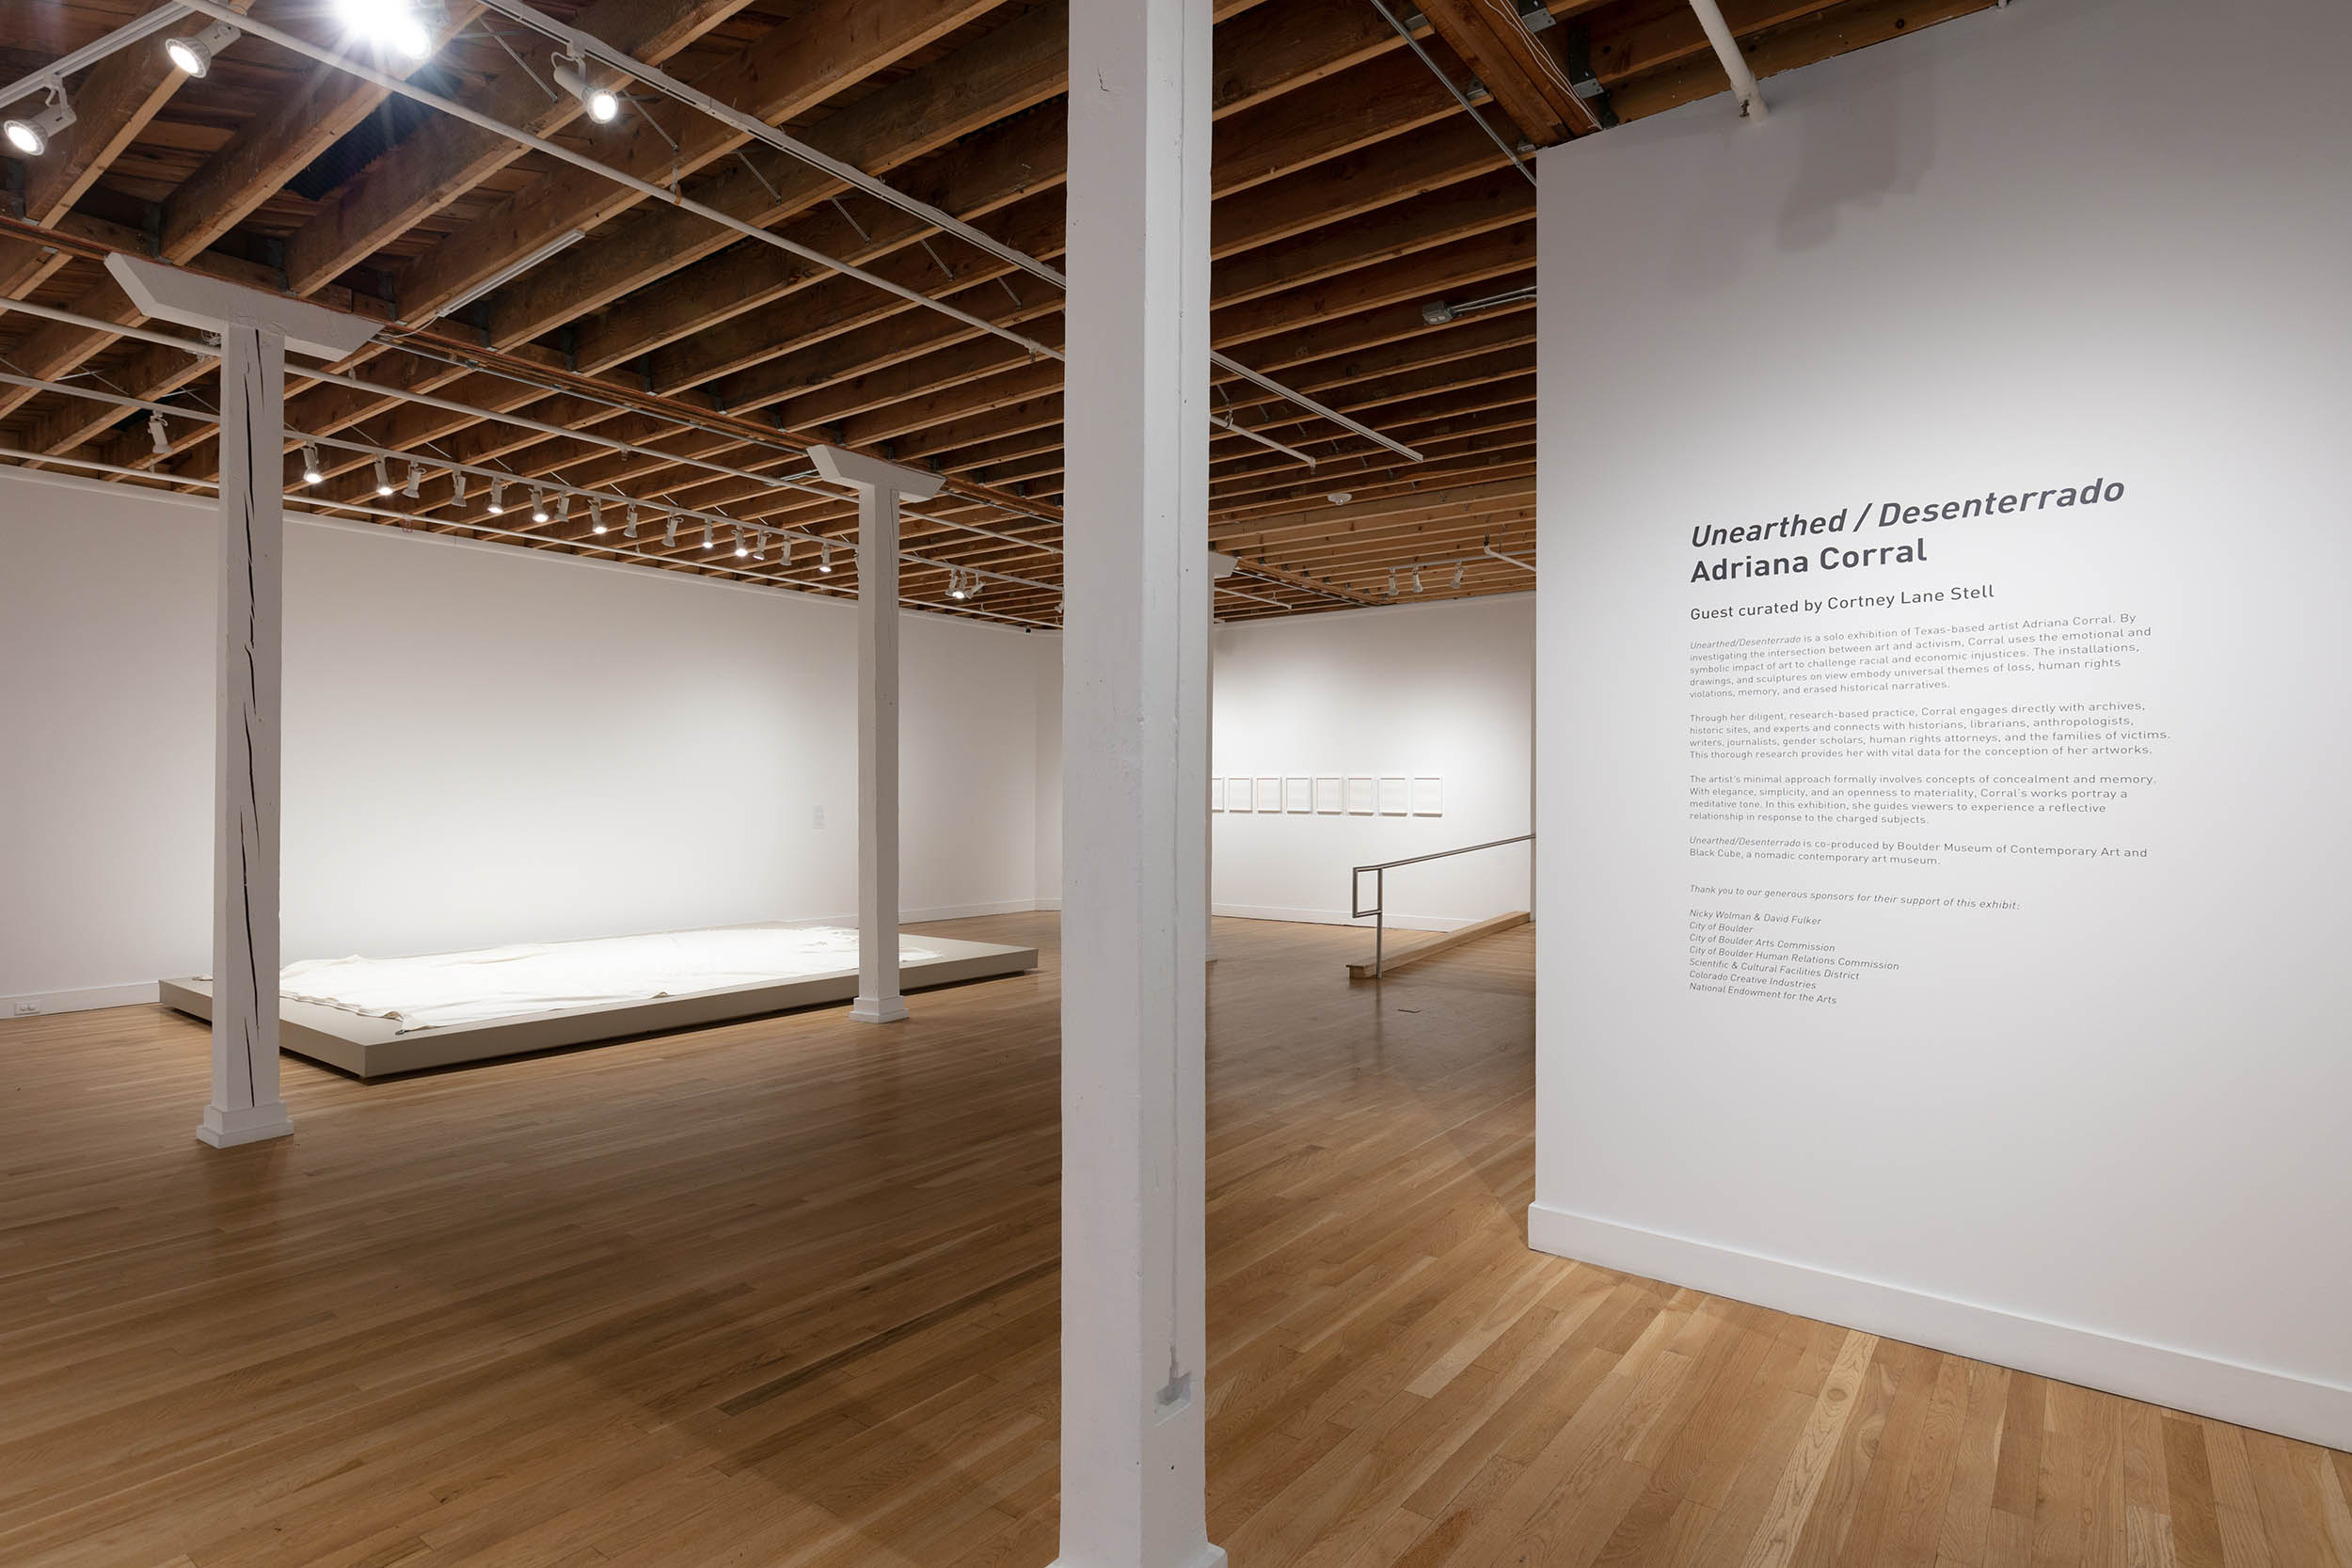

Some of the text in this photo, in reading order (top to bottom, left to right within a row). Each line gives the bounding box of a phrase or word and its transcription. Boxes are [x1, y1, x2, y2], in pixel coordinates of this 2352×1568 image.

[1692, 508, 1848, 547] Unearthed
[1878, 477, 2124, 527] Desenterrado
[1690, 538, 1927, 583] Adriana Corral
[1690, 584, 1994, 621] Guest curated by Cortney Lane Stell
[1690, 635, 1801, 649] Unearthed/Desenterrado
[1823, 632, 1844, 641] solo
[1848, 629, 1898, 640] exhibition
[1900, 627, 1911, 636] of
[1914, 623, 1985, 636] Texas-based
[1988, 621, 2019, 632] artist
[2023, 618, 2068, 629] Adriana
[2073, 614, 2115, 626] Corral.
[2121, 613, 2137, 625] By
[1690, 653, 1748, 662] investigating
[1768, 647, 1827, 657] intersection
[1829, 645, 1872, 655] between
[1893, 641, 1912, 650] and
[1915, 640, 1964, 649] activism,
[1968, 635, 2004, 646] Corral
[2008, 634, 2036, 643] uses
[2040, 633, 2058, 642] the
[2062, 628, 2124, 641] emotional
[2128, 626, 2151, 637] and
[1690, 677, 1733, 687] drawings,
[1737, 675, 1754, 684] and
[1756, 674, 1807, 685] sculptures
[1850, 669, 1891, 679] embody
[1895, 666, 1944, 677] universal
[1947, 664, 1990, 674] themes
[1993, 662, 2004, 673] of
[2008, 663, 2034, 672] loss,
[2038, 661, 2081, 671] human
[2085, 657, 2121, 671] rights
[1690, 702, 2145, 723] Through her diligent, research-based practice, Corral engages directly with archives,
[1690, 726, 1724, 735] historic
[1725, 725, 1750, 735] sites,
[1754, 724, 1771, 734] and
[1772, 723, 1810, 736] experts
[1812, 723, 1831, 732] and
[1832, 723, 1880, 732] connects
[1908, 721, 1966, 730] historians,
[1970, 719, 2030, 730] librarians,
[2032, 716, 2134, 728] anthropologists,
[1743, 775, 1782, 784] minimal
[1784, 775, 1831, 784] approach
[1835, 775, 1877, 784] formally
[1925, 775, 1977, 785] concepts
[1993, 774, 2070, 784] concealment
[2074, 774, 2096, 784] and
[2100, 775, 2156, 785] memory.
[1690, 800, 1737, 808] meditative
[1777, 800, 1795, 809] this
[1797, 800, 1850, 811] exhibition,
[1851, 801, 1870, 810] she
[1874, 801, 1908, 812] guides
[1912, 801, 1953, 813] viewers
[1957, 802, 1968, 811] to
[1970, 804, 2034, 813] experience
[2046, 802, 2106, 813] reflective
[1690, 836, 2147, 858] Unearthed/Desenterrado is co-produced by Boulder Museum of Contemporary Art and
[1690, 848, 1715, 857] Black
[1716, 848, 1744, 858] Cube,
[1754, 851, 1795, 860] nomadic
[1797, 853, 1869, 864] contemporary
[1872, 855, 1887, 863] art
[1691, 884, 1716, 894] Thank
[1718, 888, 1733, 896] you
[1764, 890, 1808, 899] generous
[1810, 893, 1854, 901] sponsors
[1857, 894, 1872, 902] for
[1874, 895, 1899, 903] their
[1900, 897, 1940, 907] support
[1944, 897, 1955, 907] of
[1957, 898, 1976, 908] this
[1979, 900, 2020, 910] exhibit:
[1690, 909, 1821, 926] Nicky Wolman & David Fulker
[1690, 921, 1754, 933] City of Boulder
[1690, 933, 1835, 952] City of Boulder Arts Commission
[1690, 945, 1707, 956] City
[1718, 947, 1754, 958] Boulder
[1756, 951, 1789, 961] Human
[1791, 953, 1836, 965] Relations
[1838, 957, 1899, 970] Commission
[1690, 958, 1859, 980] Scientific & Cultural Facilities District
[1690, 970, 1816, 990] Colorado Creative Industries
[1690, 982, 1836, 1004] National Endowment for the Arts
